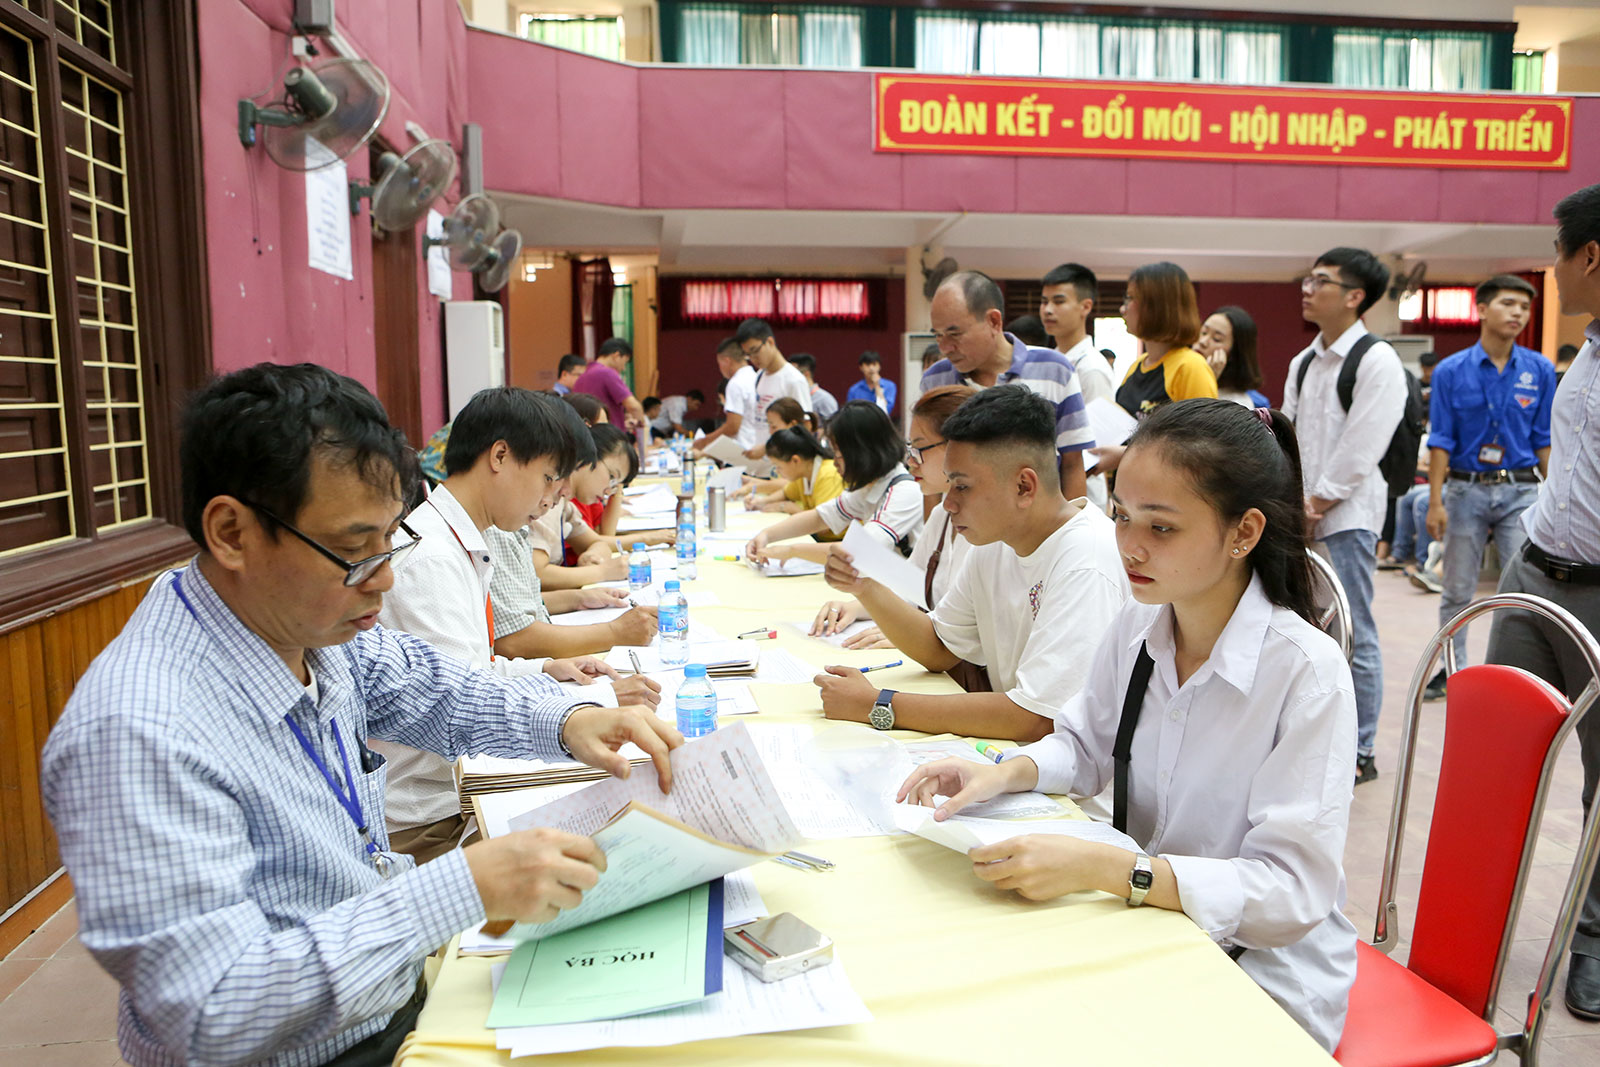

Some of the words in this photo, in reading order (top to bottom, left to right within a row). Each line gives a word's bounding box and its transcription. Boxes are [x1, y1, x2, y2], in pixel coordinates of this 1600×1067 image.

[899, 94, 988, 135] ĐOÀN
[996, 93, 1054, 137] KẾT
[1061, 118, 1075, 128] -
[1082, 93, 1135, 140] ĐỔI
[1142, 102, 1201, 142] MỚI
[1209, 123, 1222, 134] -
[1229, 104, 1280, 151] HỘI
[1286, 107, 1367, 154] NHẬP
[1373, 129, 1387, 139] -
[1393, 111, 1468, 150] PHÁT
[1473, 108, 1553, 152] TRIỂN
[565, 957, 595, 968] BẠ
[602, 951, 655, 965] HỌC
